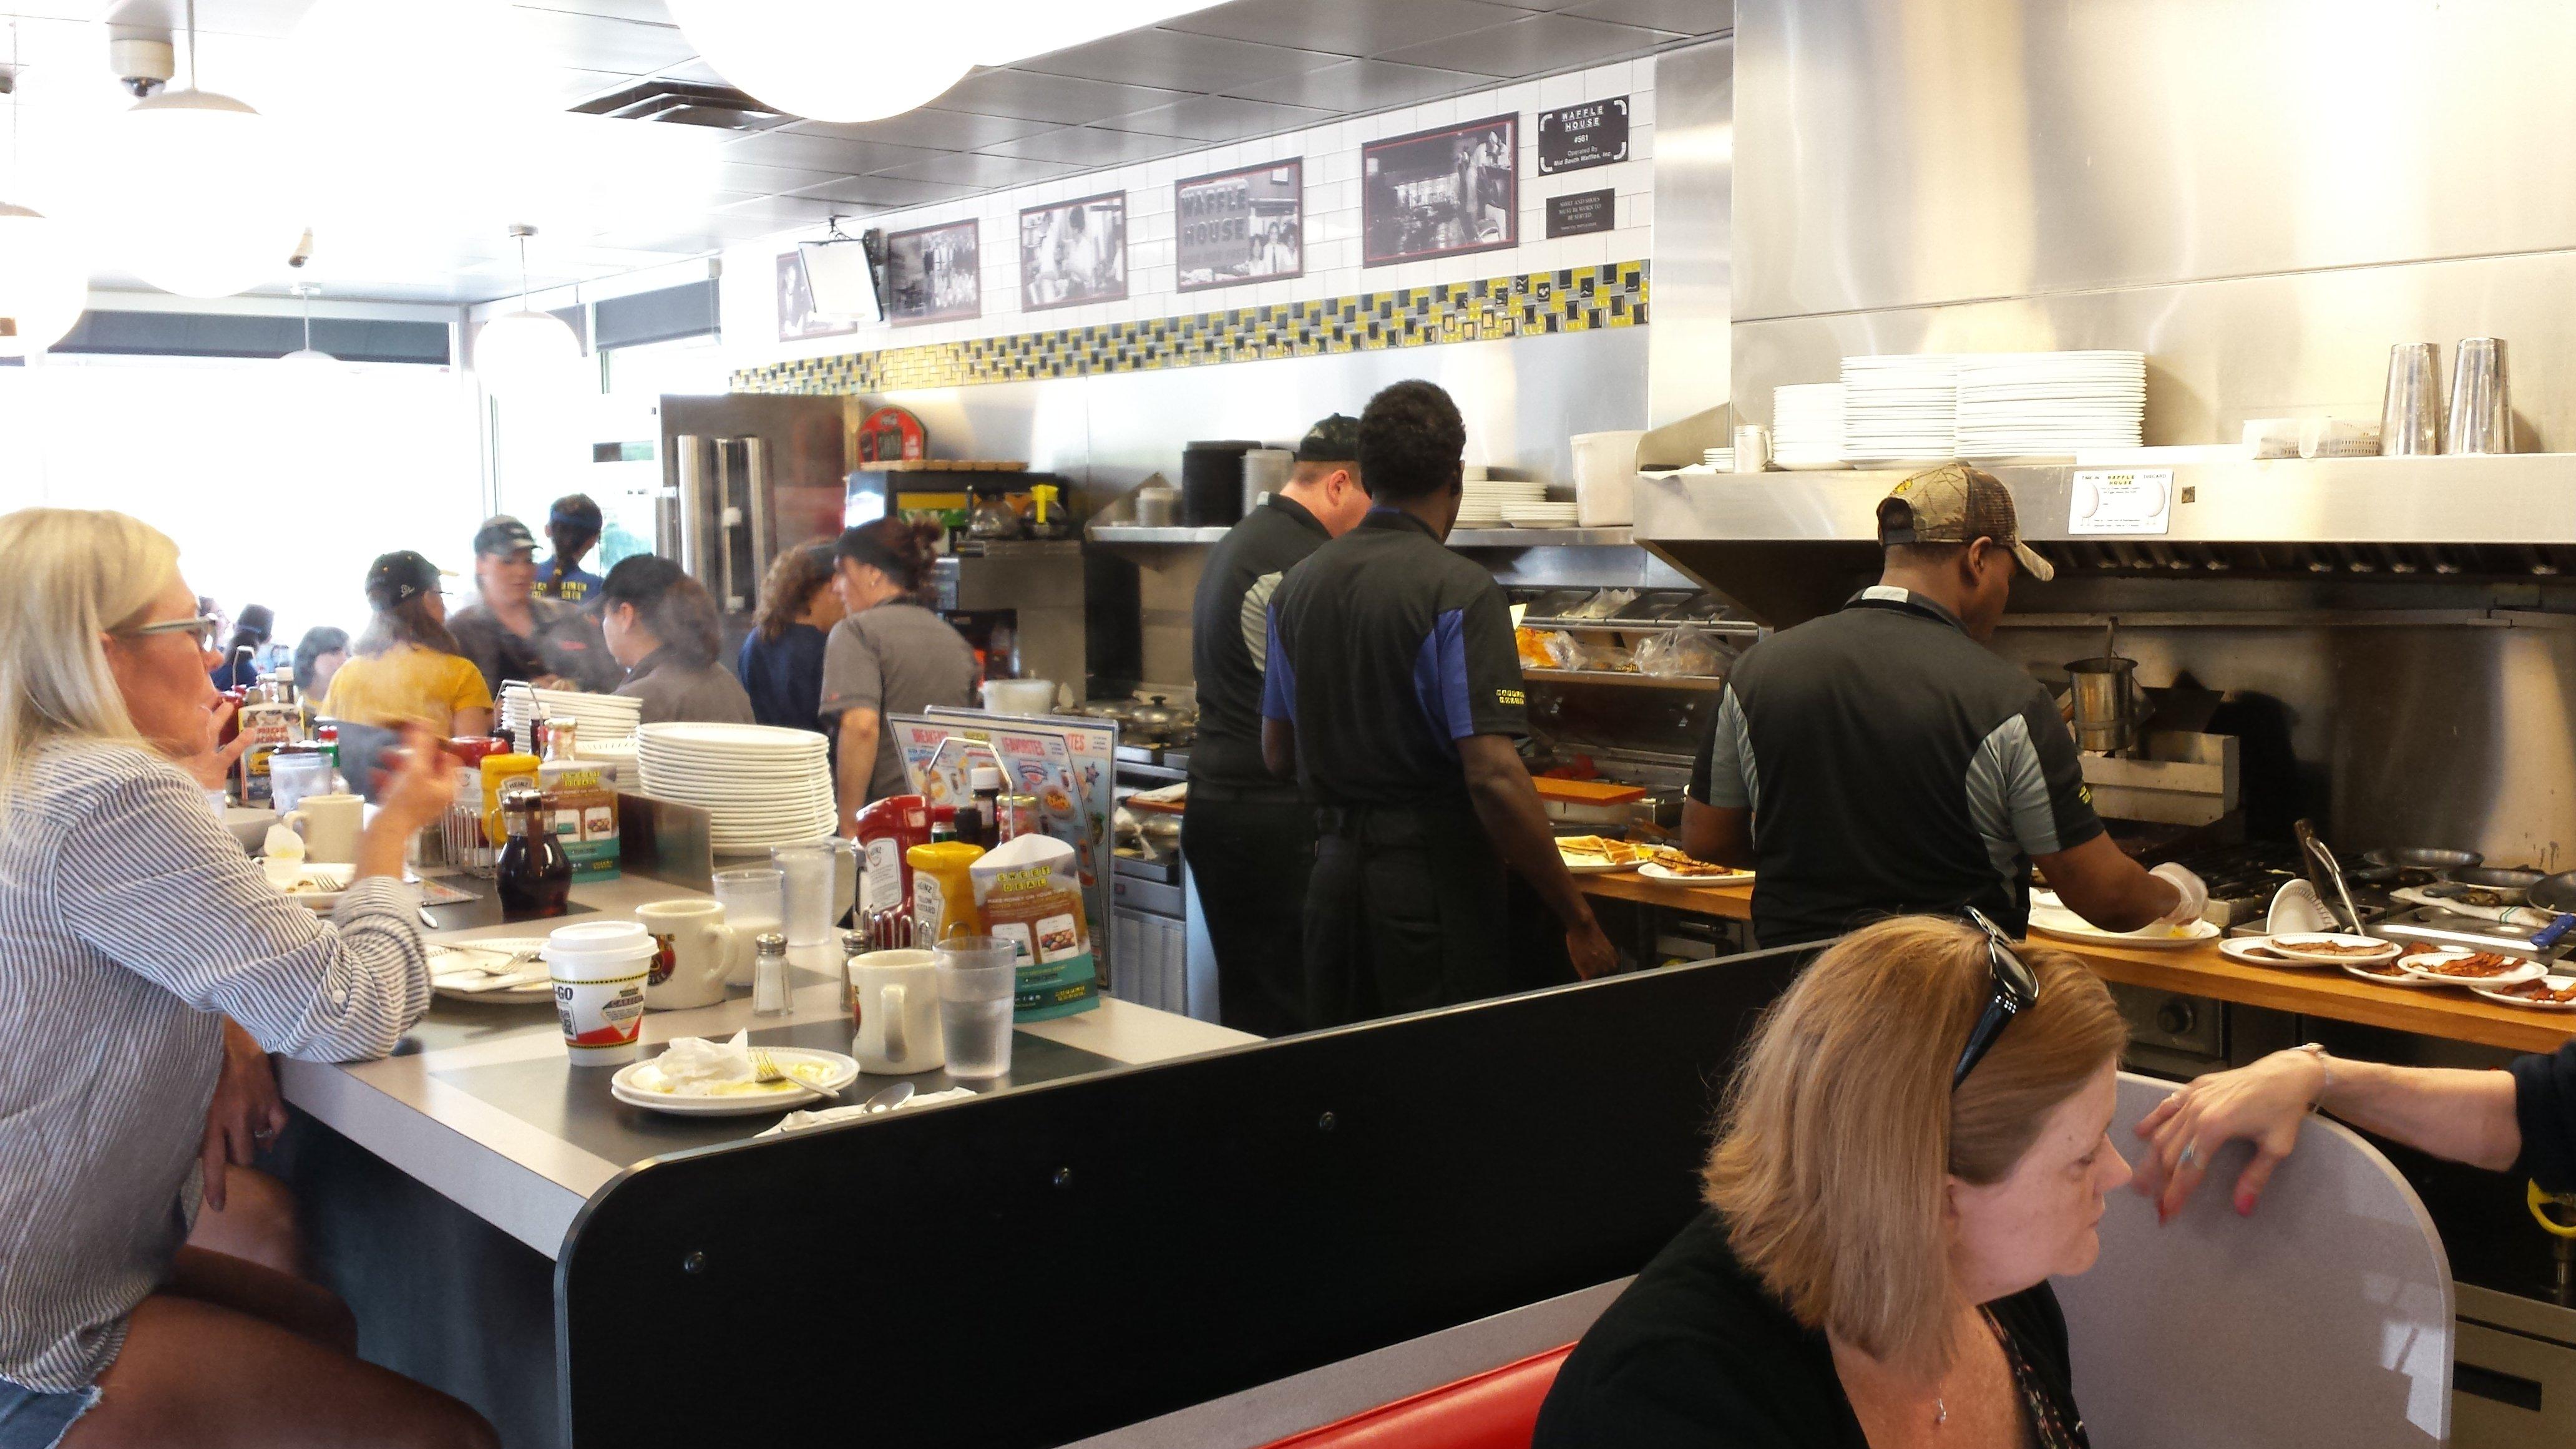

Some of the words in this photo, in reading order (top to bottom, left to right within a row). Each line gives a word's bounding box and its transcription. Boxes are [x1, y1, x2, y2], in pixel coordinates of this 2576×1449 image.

[1562, 105, 1603, 122] WAFFLE
[1565, 117, 1599, 132] HOUSE
[1181, 185, 1246, 217] WAFFLE
[1184, 218, 1244, 247] HOUSE
[997, 866, 1051, 882] SWEET
[1003, 877, 1048, 892] DEAL
